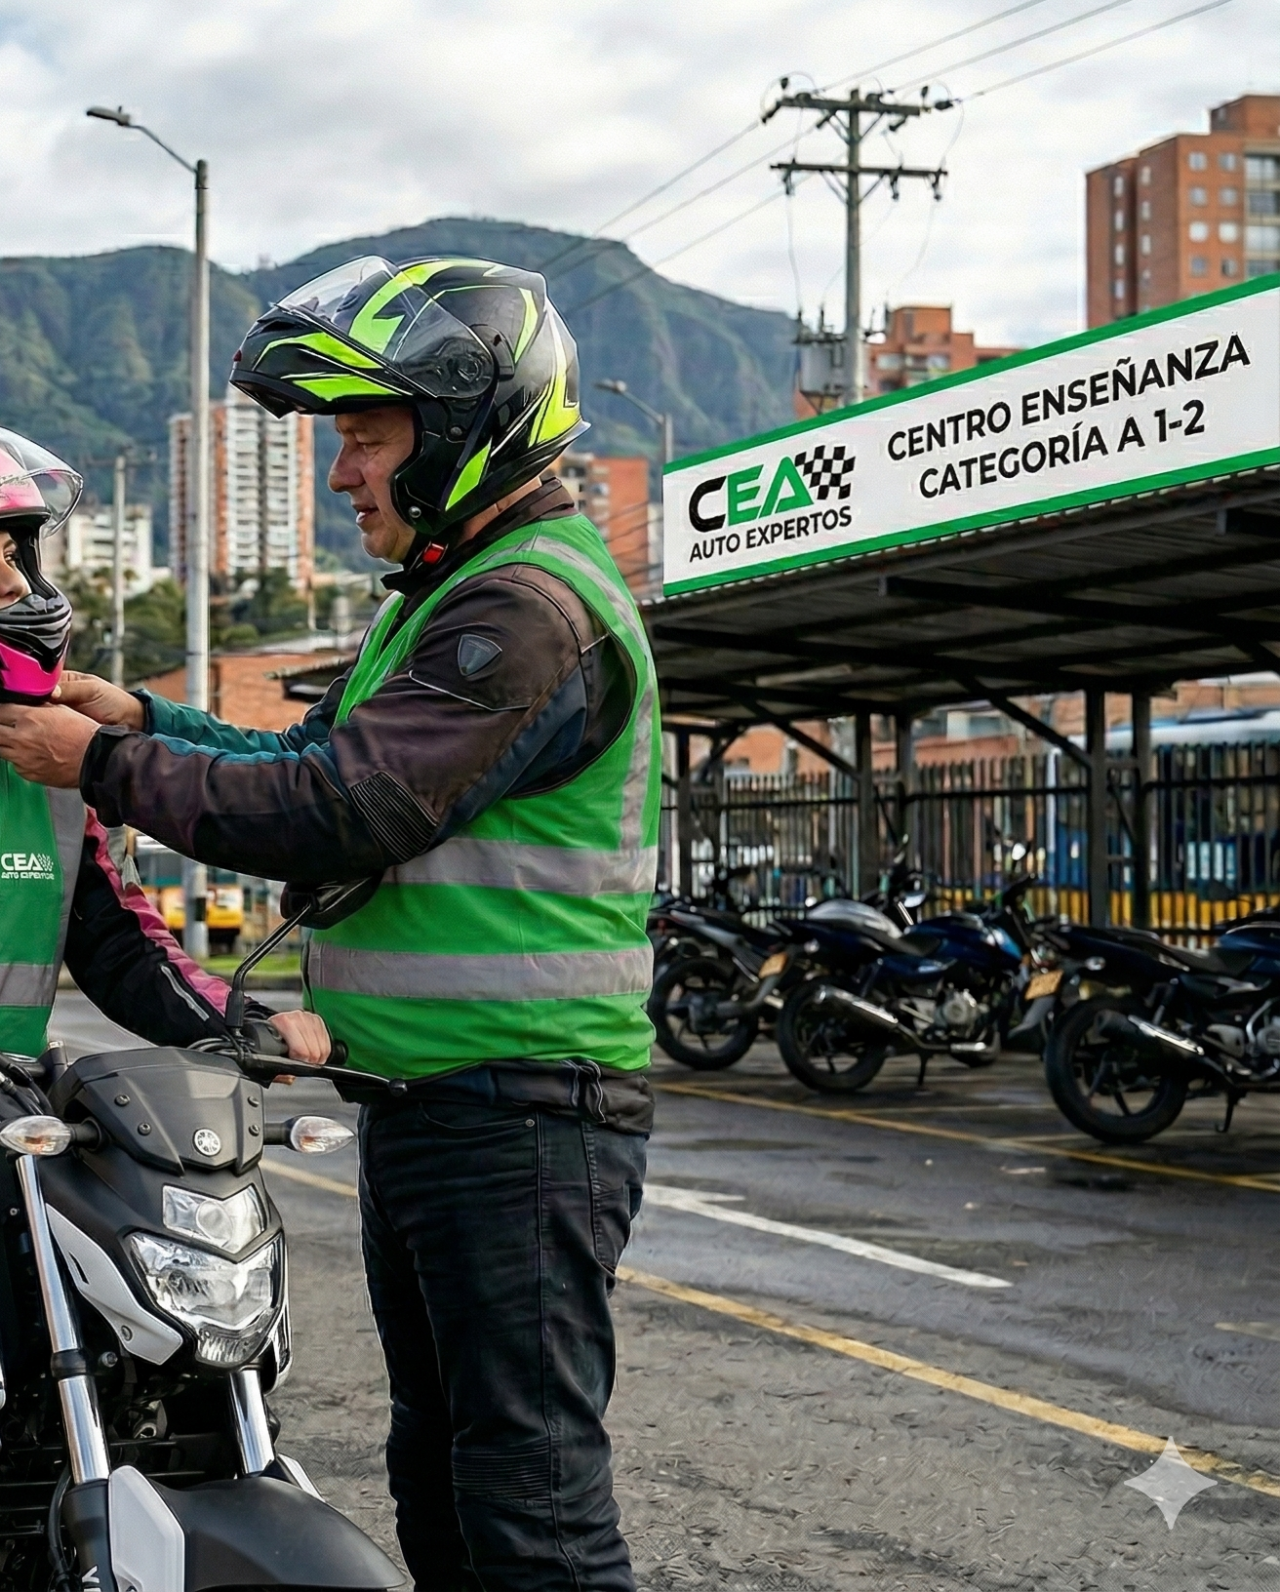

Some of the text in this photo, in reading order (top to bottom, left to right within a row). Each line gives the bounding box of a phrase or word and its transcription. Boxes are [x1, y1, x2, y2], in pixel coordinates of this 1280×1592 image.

[888, 334, 1251, 461] CENTRO ENSEÑANZA
[920, 399, 1206, 499] CATEGORÍA A 1-2
[688, 456, 815, 533] CEA
[689, 505, 853, 563] AUTO EXPERTOS
[1, 853, 44, 871] CEA
